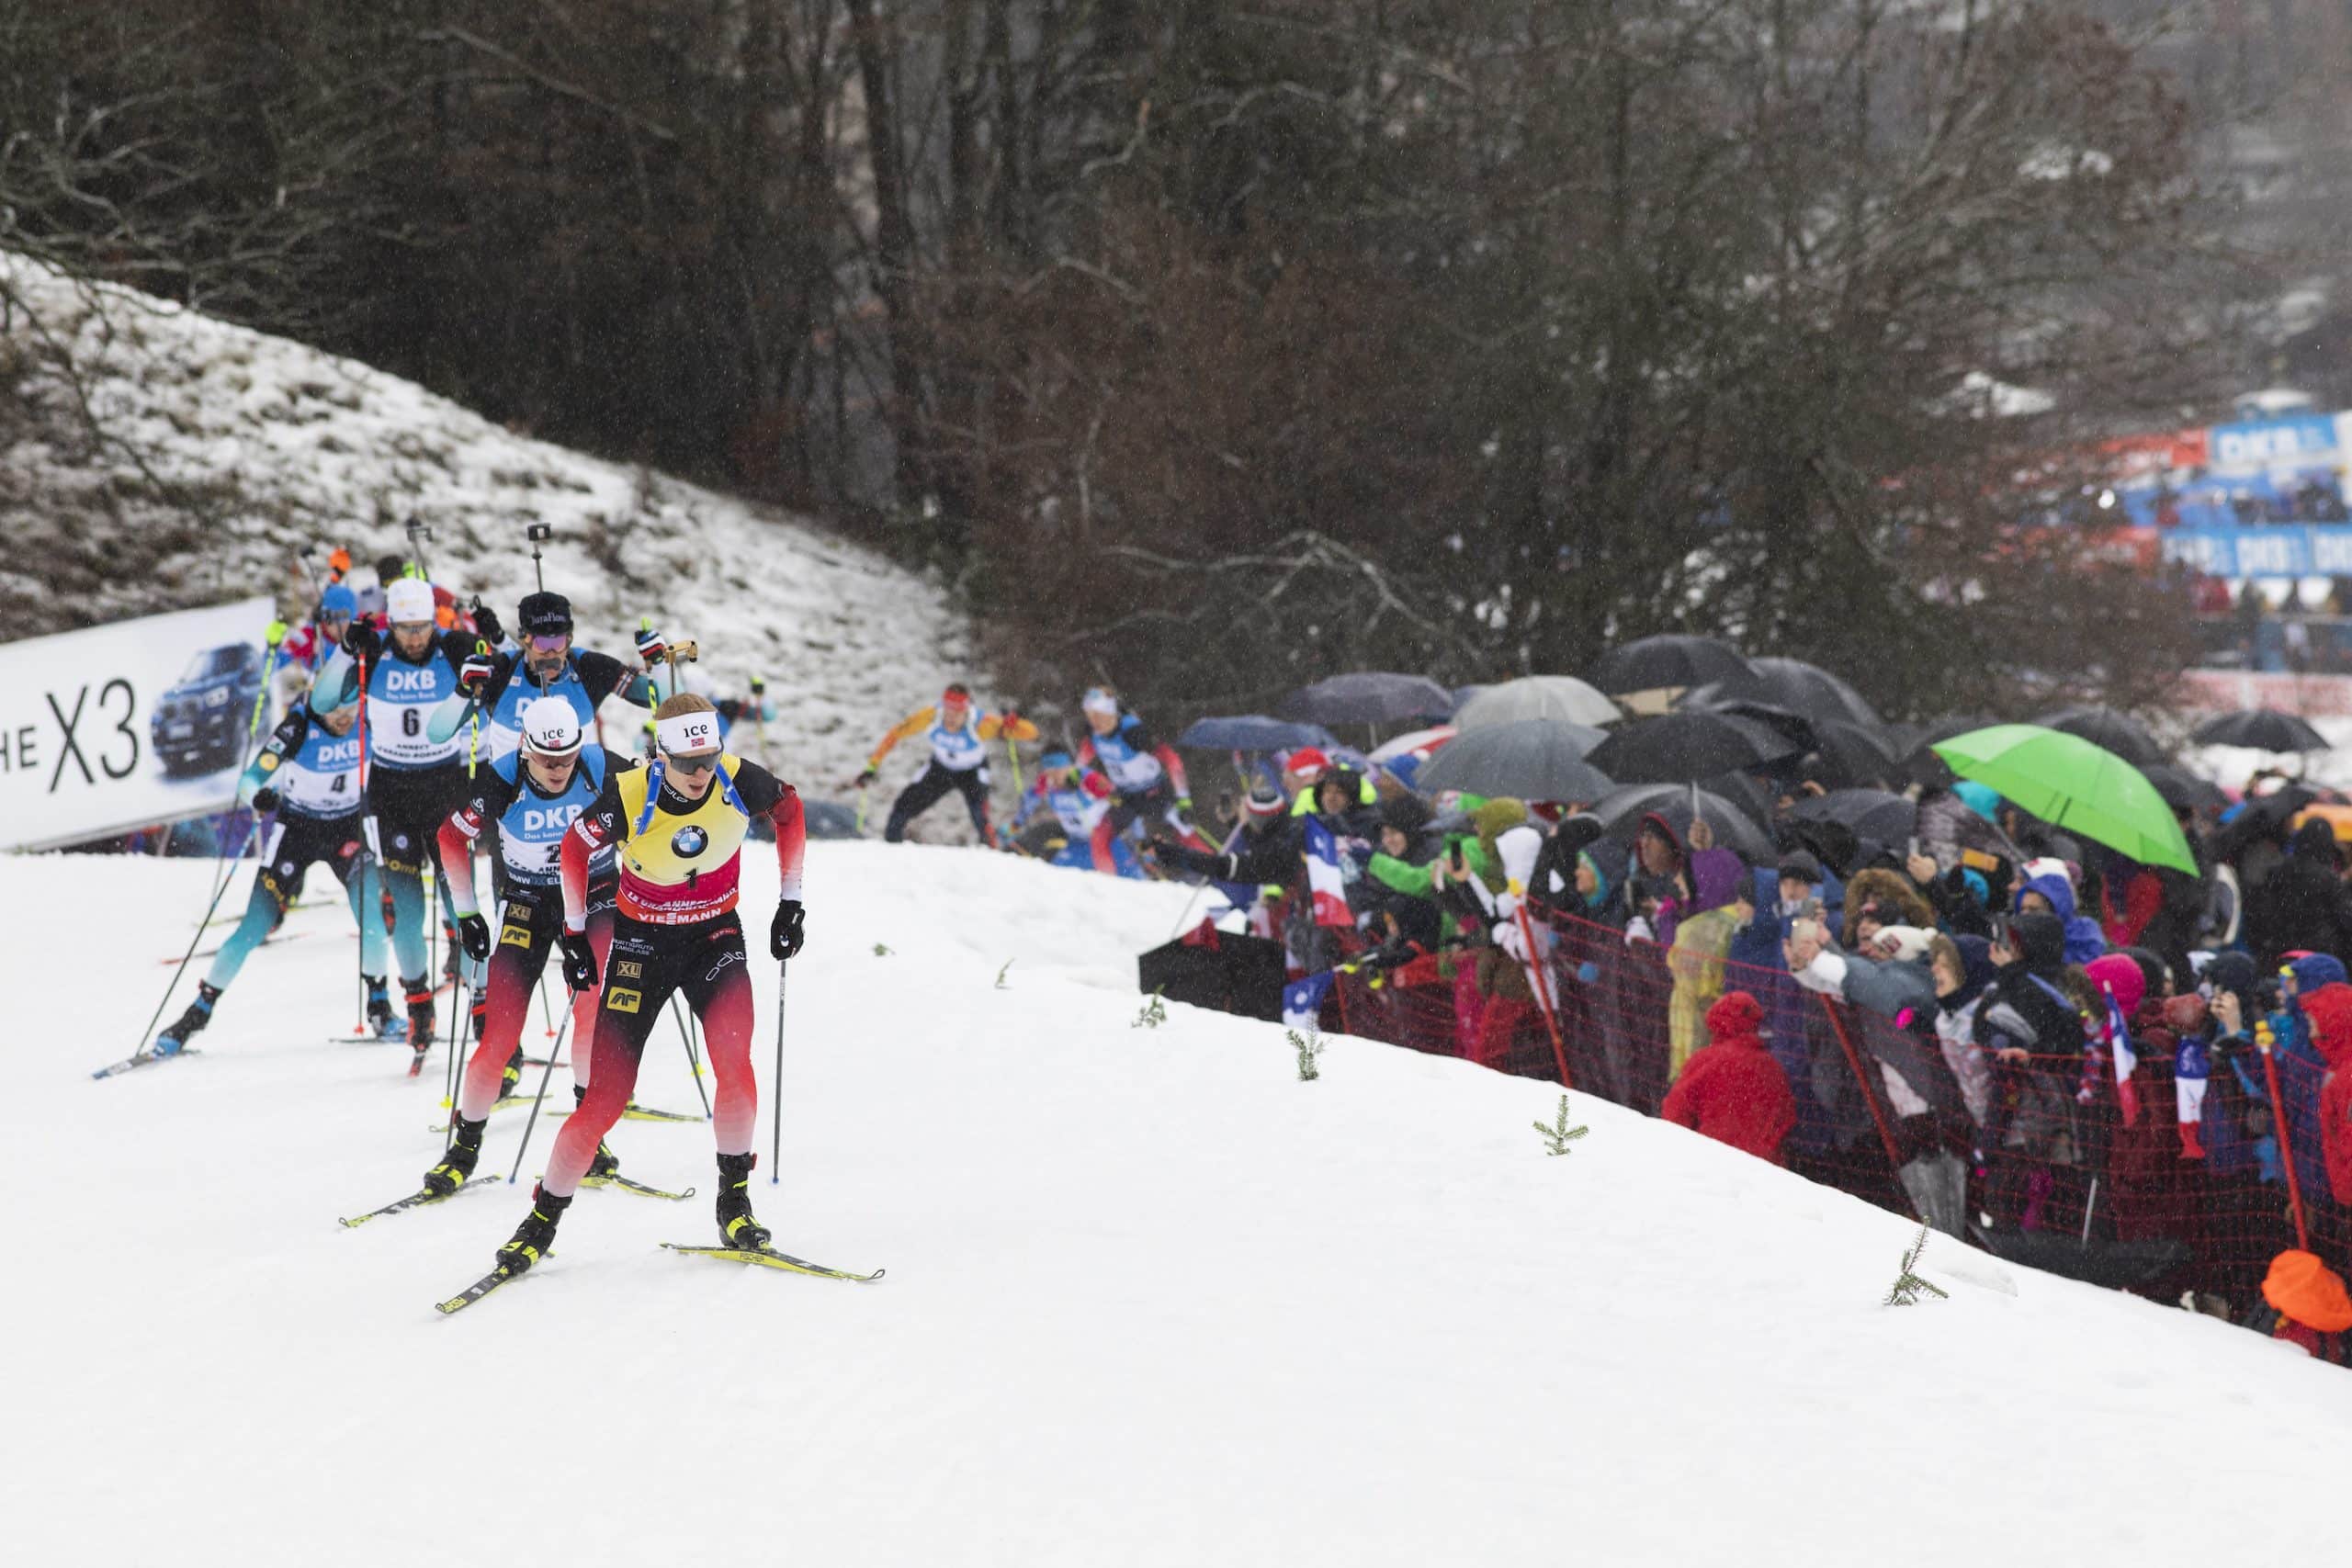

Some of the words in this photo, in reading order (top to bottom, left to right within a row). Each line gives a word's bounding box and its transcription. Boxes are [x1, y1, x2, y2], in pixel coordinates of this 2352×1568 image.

[2220, 426, 2297, 461] DKB
[387, 670, 436, 691] DKB
[402, 708, 420, 737] 6
[46, 678, 139, 794] X3
[318, 739, 361, 763] DKB
[331, 774, 346, 794] 4
[524, 832, 540, 840] Das
[542, 829, 563, 839] kann
[545, 843, 560, 863] 2
[684, 867, 698, 889] 1
[511, 904, 530, 920] XL
[618, 963, 640, 976] XL
